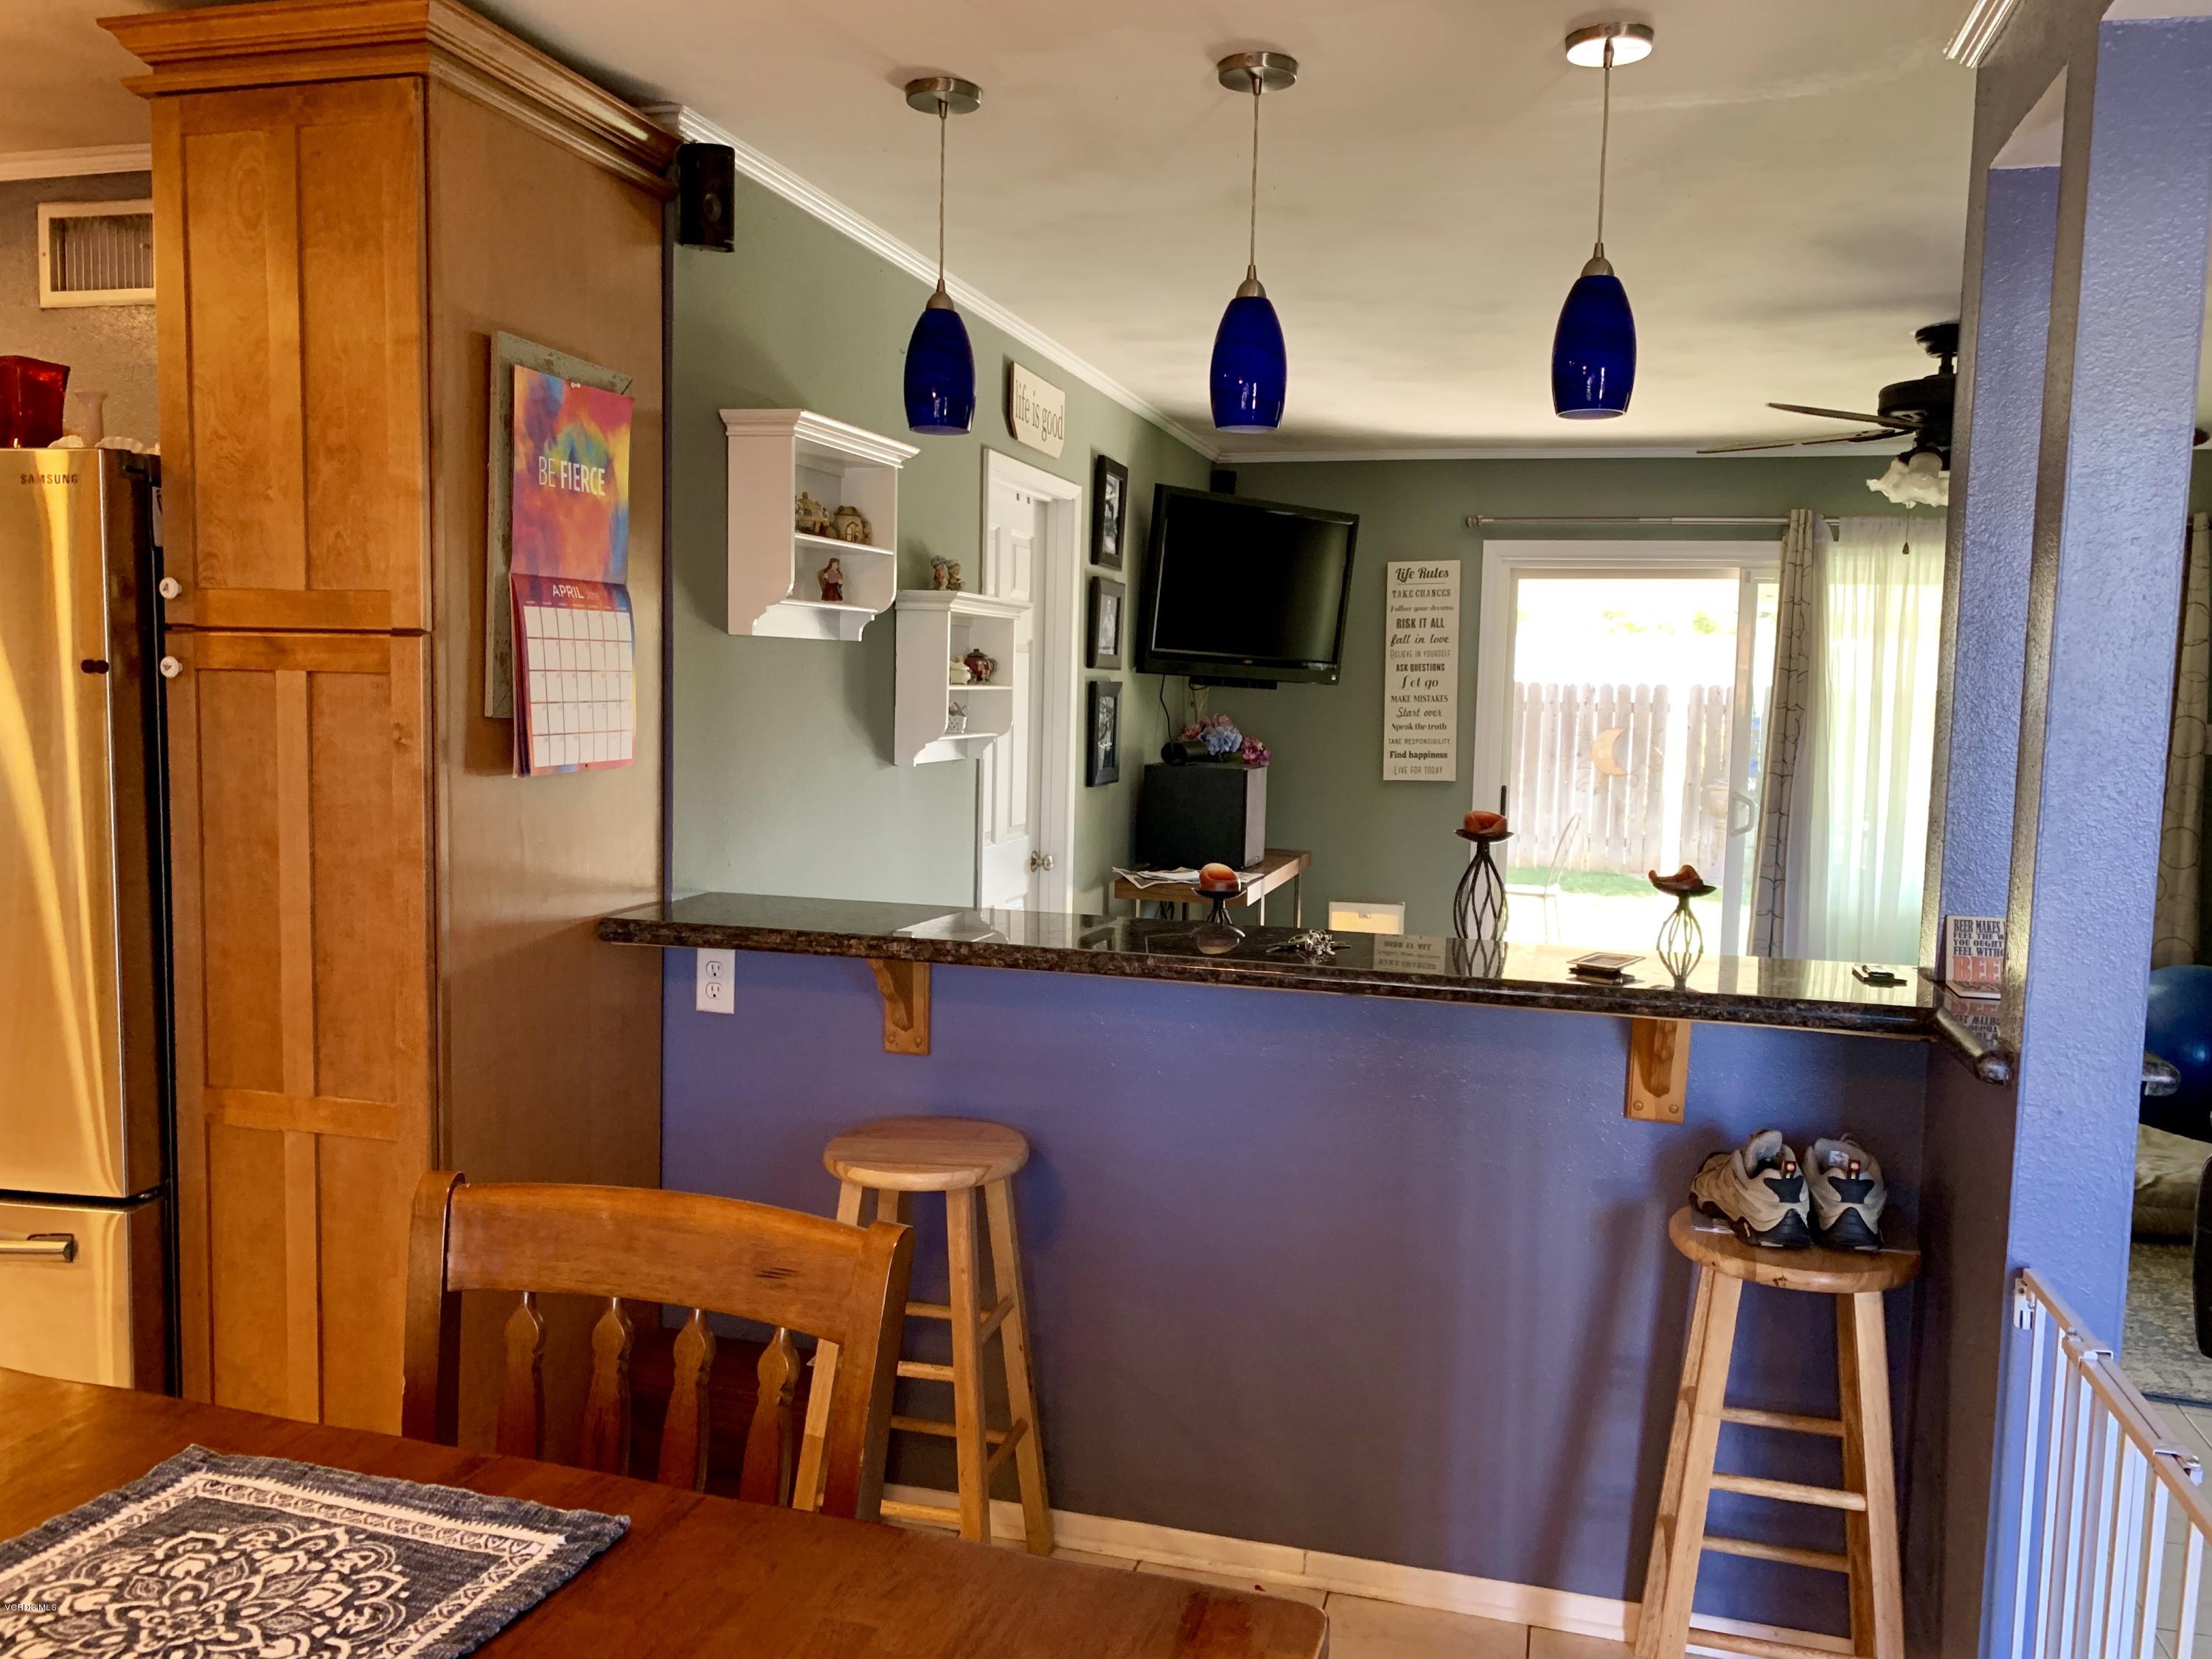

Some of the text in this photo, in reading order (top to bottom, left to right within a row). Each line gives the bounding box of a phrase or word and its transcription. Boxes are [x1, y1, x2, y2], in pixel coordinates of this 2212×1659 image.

[1015, 379, 1063, 442] life is good
[539, 456, 605, 496] BE FIERCE
[1396, 567, 1449, 582] Life Rules
[552, 584, 584, 599] APRIL
[1392, 589, 1451, 598] TAKE CHANCES
[1397, 617, 1444, 629] RISK IT ALL
[1391, 633, 1450, 647] fall in love
[1415, 650, 1421, 658] IN
[1396, 663, 1445, 672] ASK QUESTIONS
[1425, 679, 1439, 689] go
[1396, 706, 1442, 718] Start over
[1392, 723, 1413, 731] Speak
[1390, 751, 1448, 760] Find happiness
[1411, 766, 1422, 774] FOR
[1425, 766, 1443, 774] TODAY
[1953, 919, 2000, 933] BEER MAKES
[1973, 940, 2003, 948] OUGHT
[1954, 947, 1972, 956] FEEL
[1952, 956, 2003, 984] BEE
